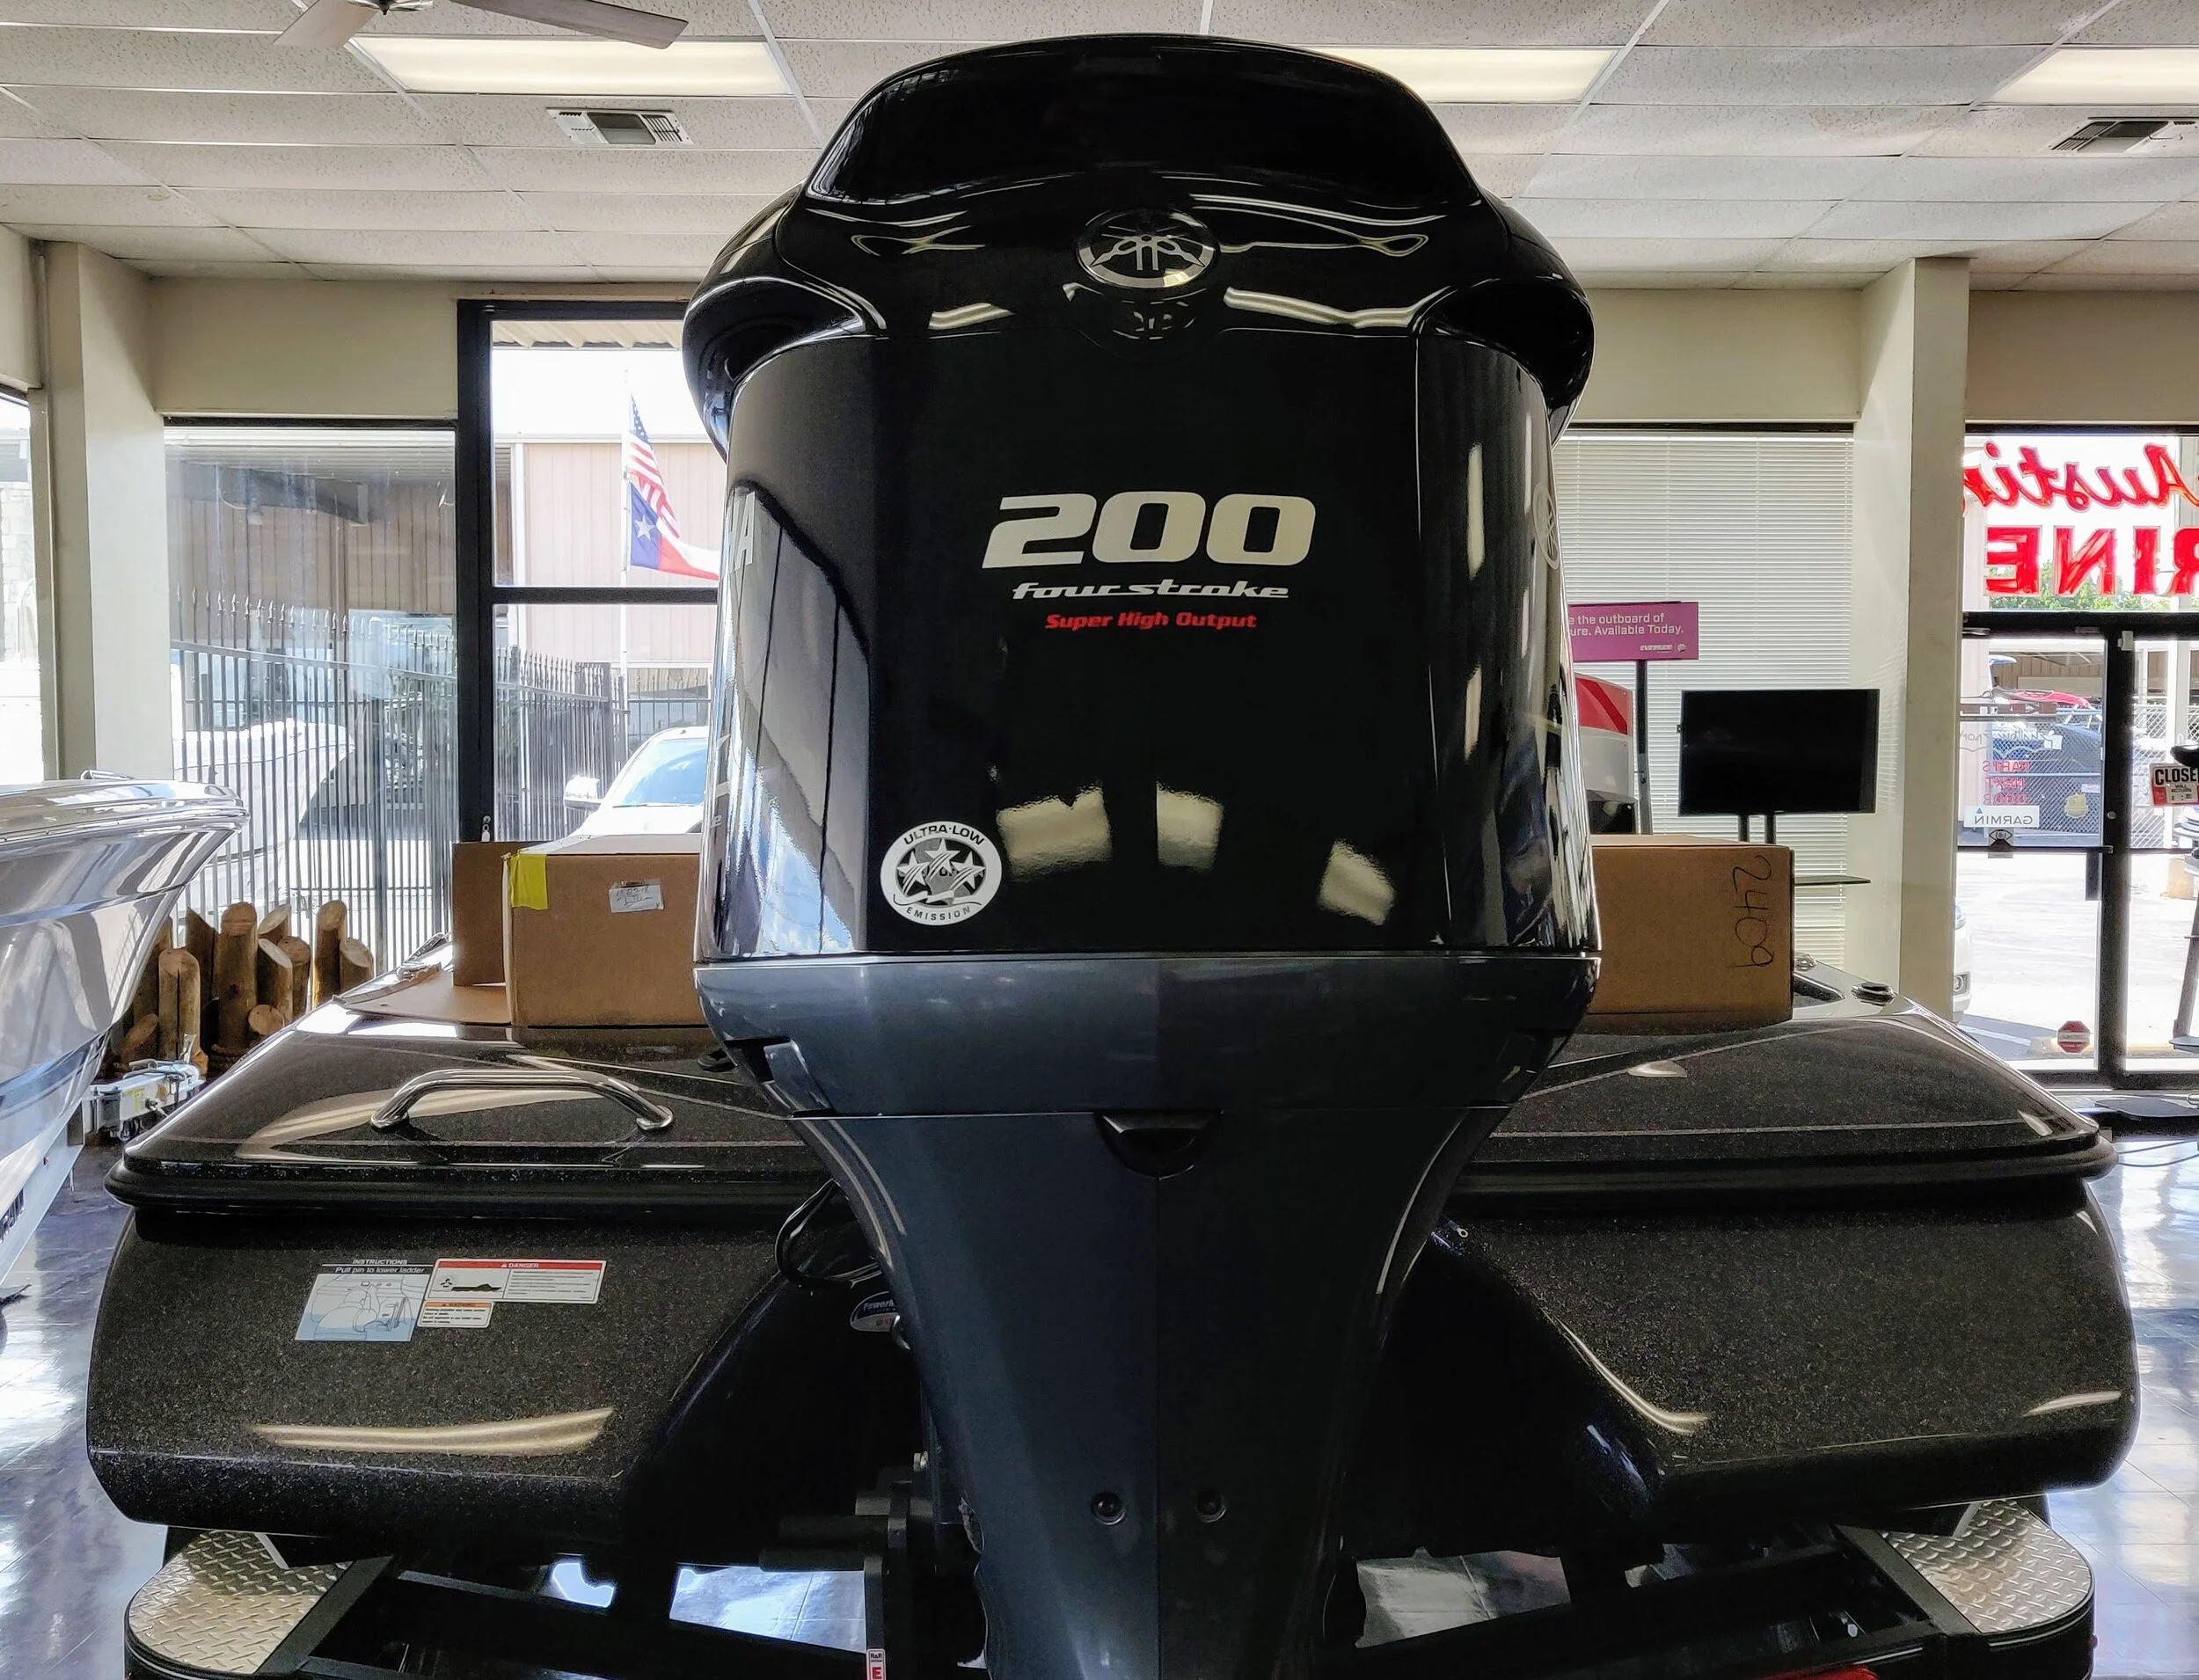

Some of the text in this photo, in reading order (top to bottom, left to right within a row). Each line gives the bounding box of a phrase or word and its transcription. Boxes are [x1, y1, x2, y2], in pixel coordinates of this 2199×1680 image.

[982, 491, 1317, 569] 200
[1045, 611, 1257, 632] Super High Output
[1577, 615, 1596, 625] the
[1599, 614, 1651, 625] outboard
[1653, 612, 1665, 623] of
[1594, 625, 1646, 635] Available
[1647, 624, 1684, 635] Today.
[2155, 767, 2199, 785] CLOSE
[906, 906, 971, 921] EMISSION
